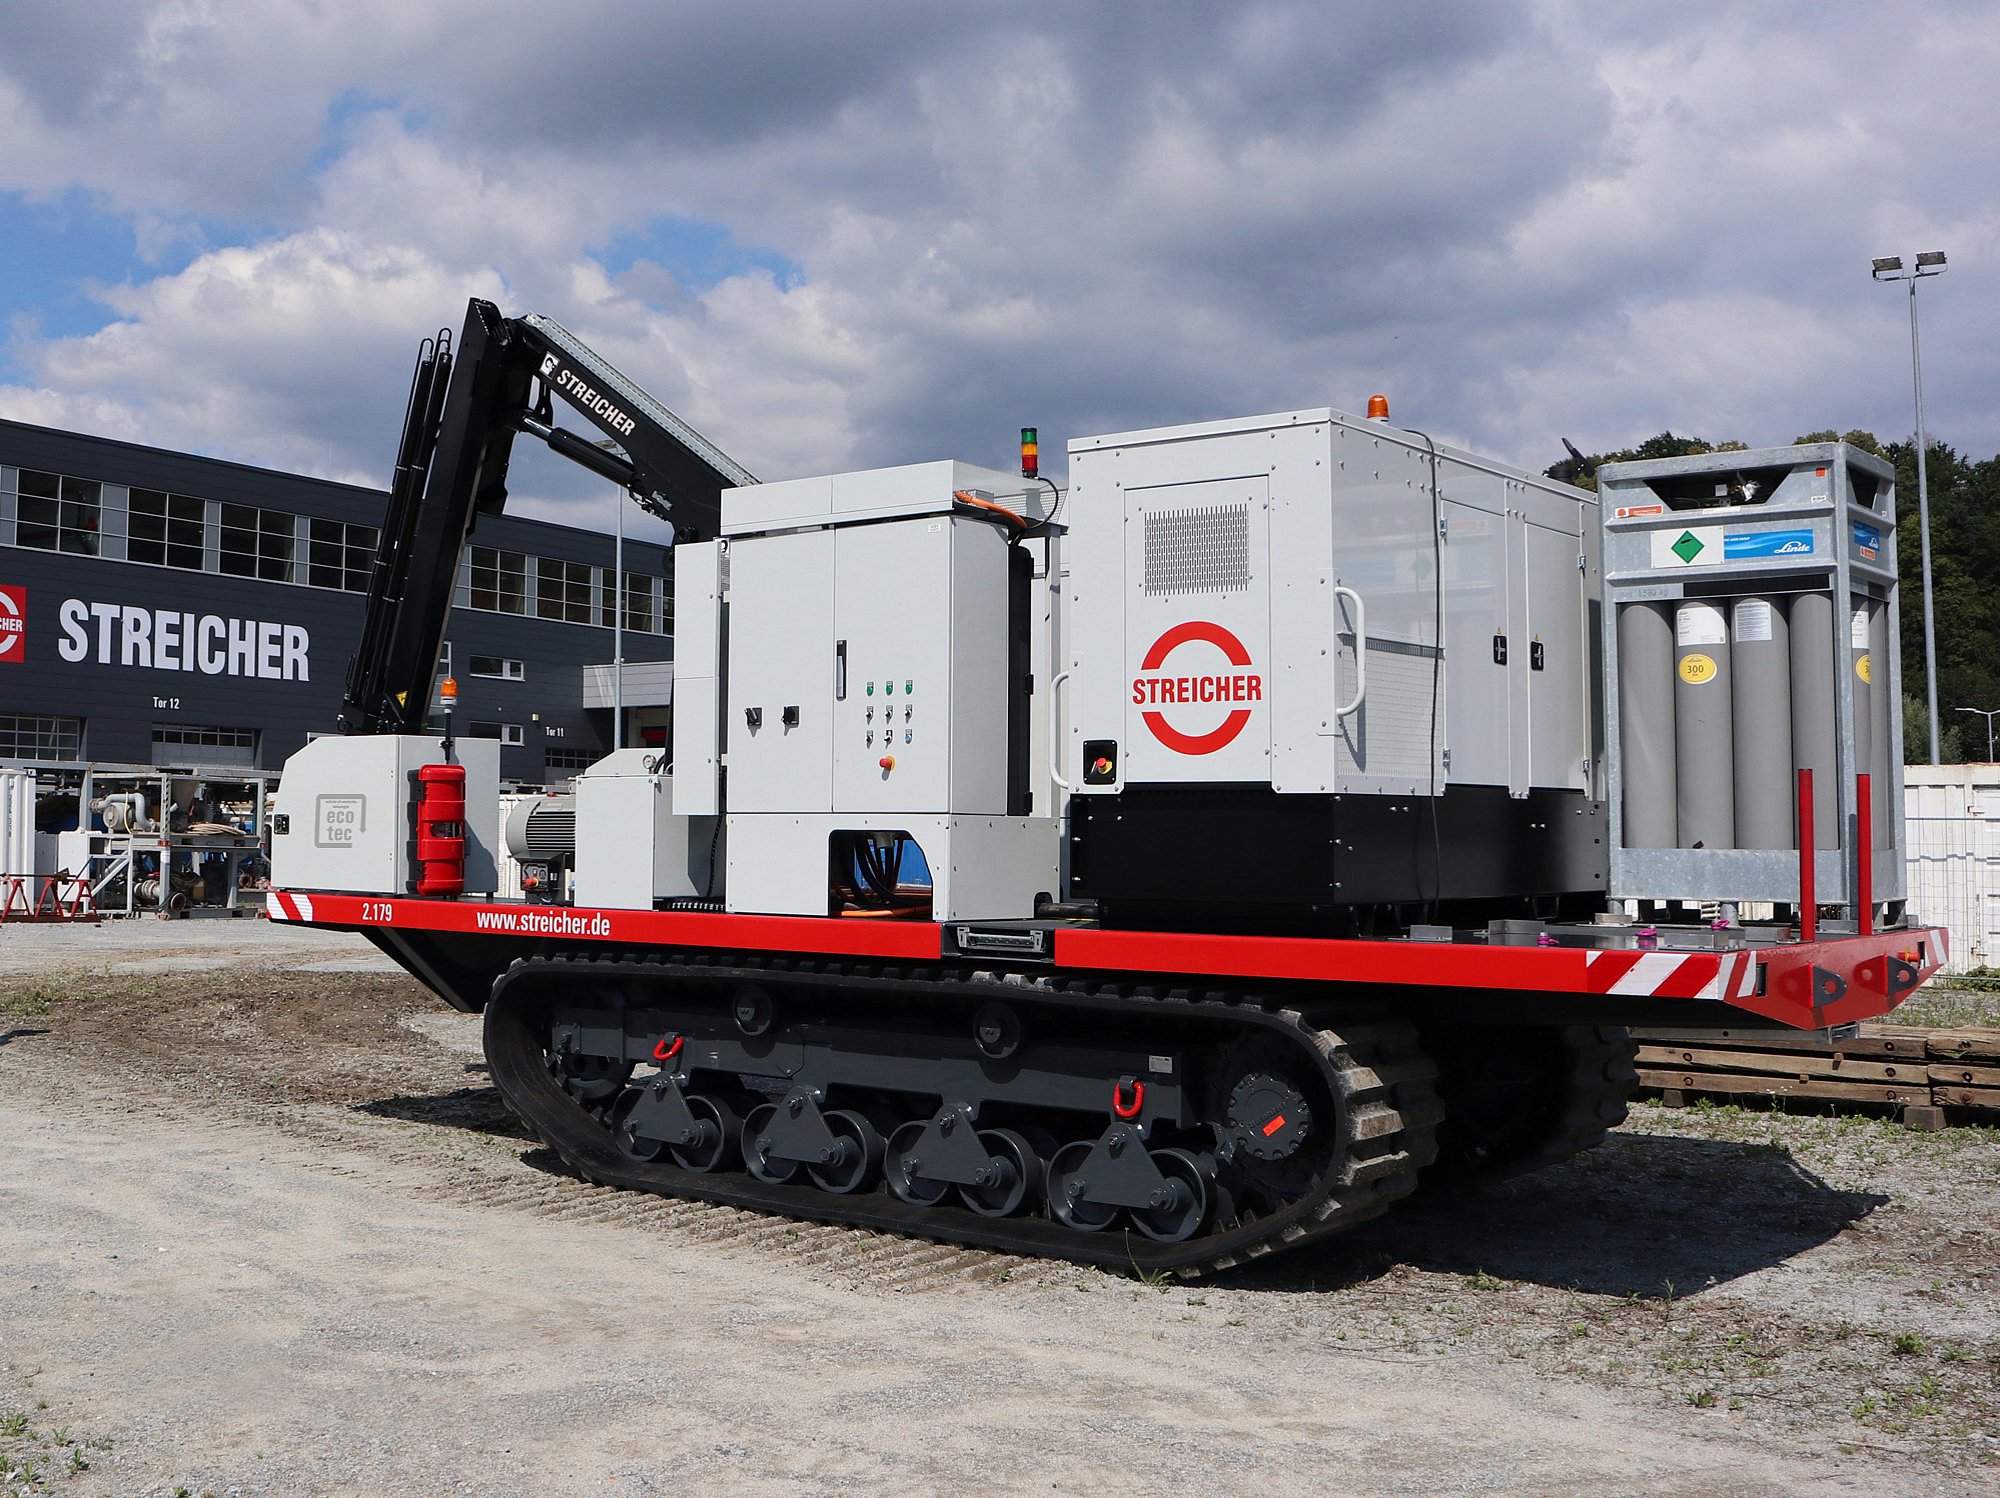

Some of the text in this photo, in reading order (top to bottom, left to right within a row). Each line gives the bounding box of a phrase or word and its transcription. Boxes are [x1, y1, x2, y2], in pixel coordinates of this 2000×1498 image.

[556, 369, 636, 436] STREICHER
[1774, 541, 1811, 553] Linde
[58, 598, 310, 682] STREICHER
[1687, 664, 1704, 674] 300
[1132, 675, 1262, 704] STREICHER
[152, 696, 180, 710] Tor 12
[545, 726, 564, 737] Tor 11
[327, 811, 354, 824] eco
[326, 825, 352, 841] tec
[362, 903, 393, 922] 2.179
[476, 910, 611, 936] www.streicher.de
